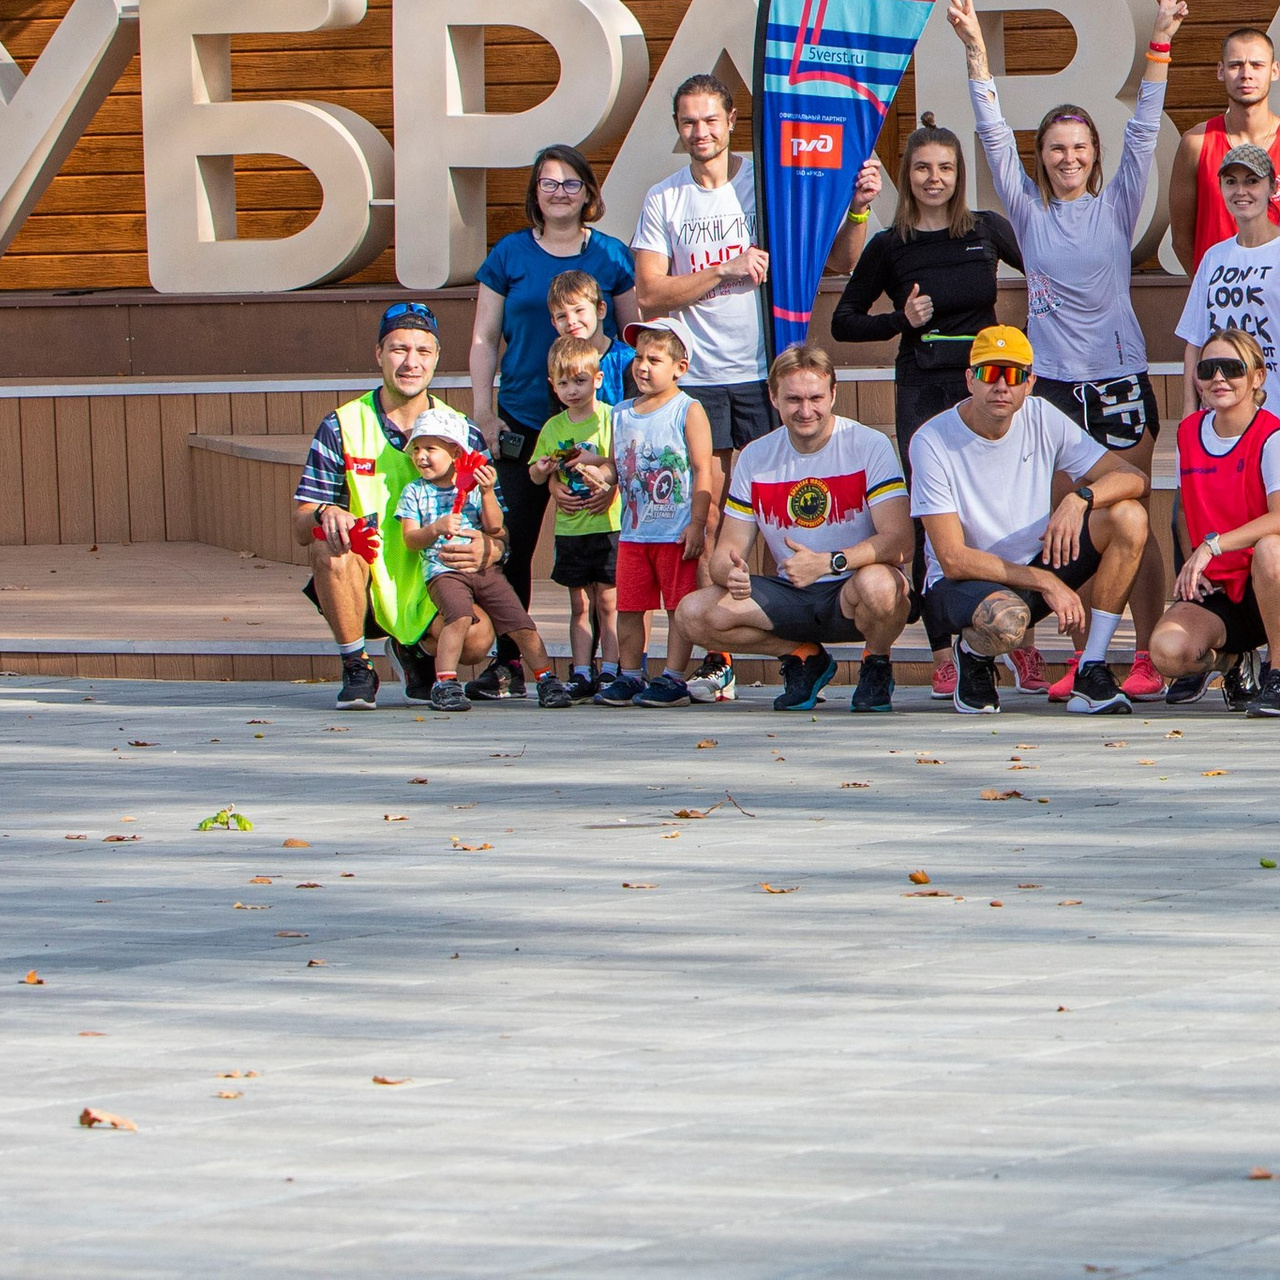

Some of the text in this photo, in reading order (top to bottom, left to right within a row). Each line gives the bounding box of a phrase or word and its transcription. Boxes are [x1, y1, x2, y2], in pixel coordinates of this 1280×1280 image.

[808, 47, 864, 65] 5verst.ru
[1209, 265, 1273, 286] DON'T
[1207, 285, 1265, 309] LOOK
